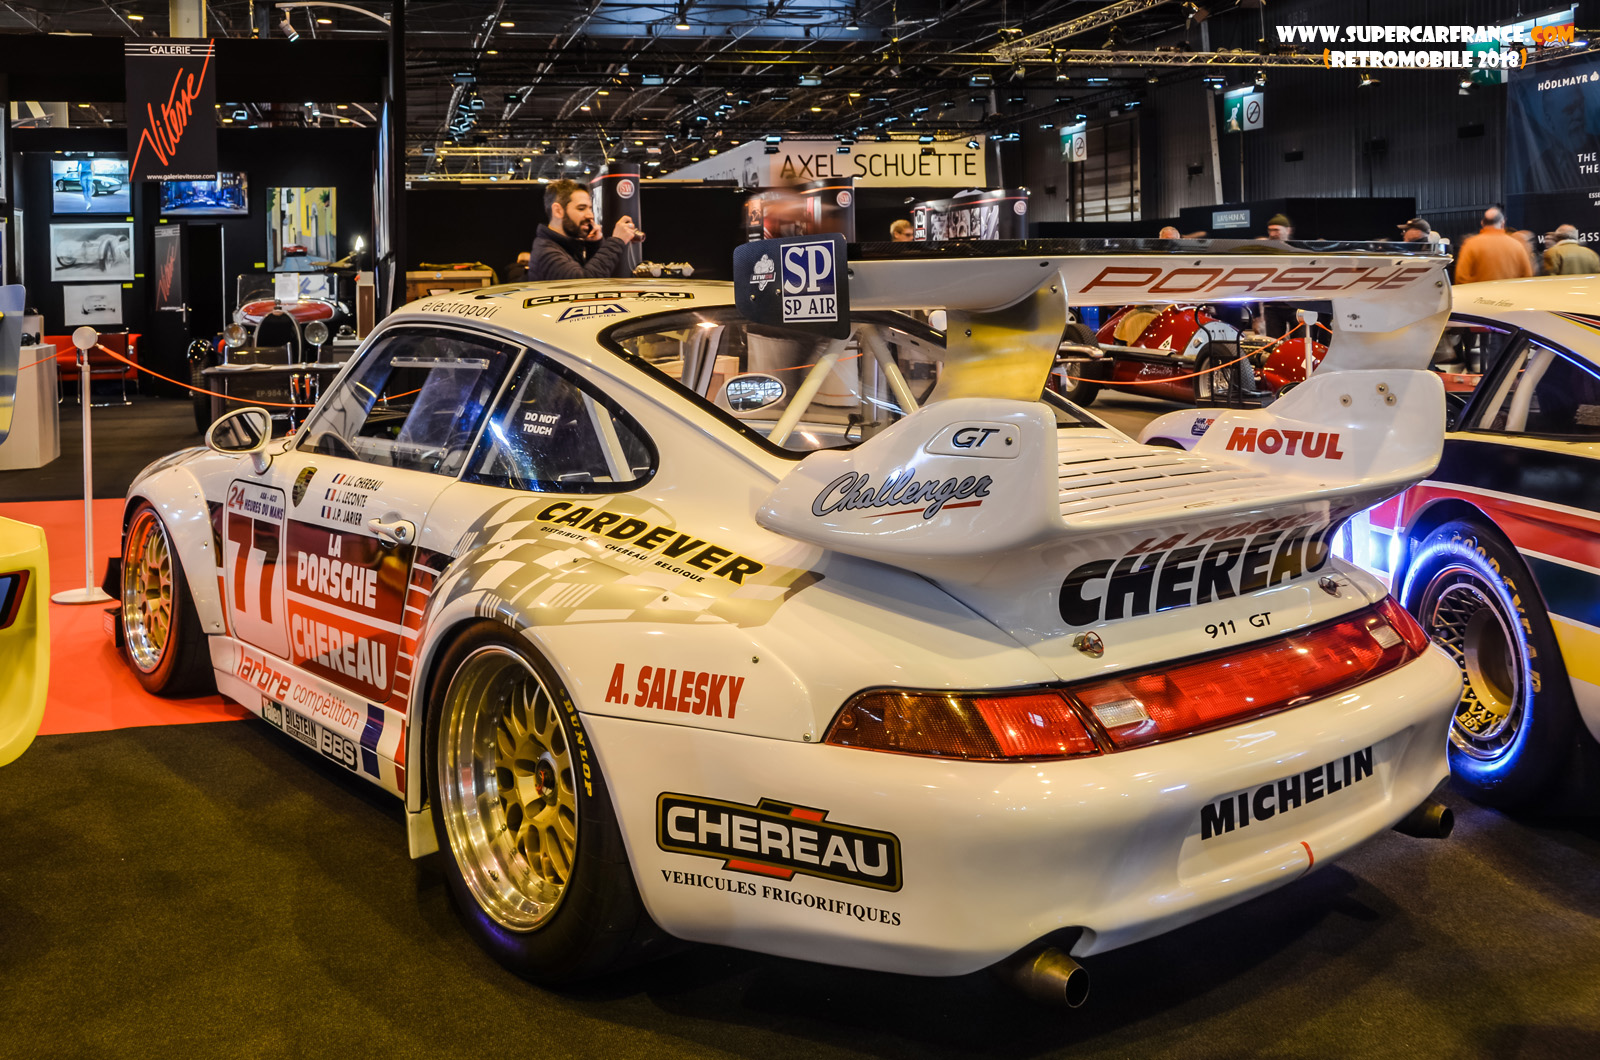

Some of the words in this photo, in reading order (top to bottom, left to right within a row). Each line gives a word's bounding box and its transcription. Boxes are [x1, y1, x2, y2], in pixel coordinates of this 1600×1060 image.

[149, 45, 191, 54] GALERIE
[1537, 73, 1588, 91] HÖDLMAYR
[129, 38, 215, 182] Vitesse
[779, 154, 843, 179] AXEL
[853, 153, 977, 178] SCHUETTE
[1577, 152, 1597, 163] THE
[146, 173, 216, 181] www.galerievitesse.com
[784, 244, 833, 295] SP
[1079, 266, 1433, 294] PORSCHE
[421, 300, 503, 319] electropoli
[530, 292, 686, 305] CHEREAU
[784, 299, 802, 316] SP
[808, 297, 836, 315] AIR
[522, 424, 553, 436] TOUCH
[524, 412, 538, 422] DO
[539, 414, 558, 425] NOT
[952, 427, 1000, 448] GT
[1225, 426, 1344, 460] MOTUL
[228, 485, 246, 510] 24
[354, 477, 384, 491] CHEREAU
[811, 467, 993, 519] Challenger
[244, 498, 262, 514] HEURES
[261, 503, 270, 516] DU
[269, 505, 284, 521] MANS
[342, 491, 368, 508] LECONTE
[343, 510, 363, 527] JARIER
[1123, 533, 1189, 556] LA
[1187, 504, 1354, 546] PORSCHE
[327, 533, 342, 558] LA
[535, 501, 766, 586] CARDEVER
[228, 511, 281, 624] 77
[604, 543, 650, 561] CHEREAU
[653, 560, 706, 584] BELGIQUE
[1059, 516, 1345, 627] CHEREAU
[296, 550, 378, 609] PORSCHE
[1204, 619, 1237, 639] 911
[1248, 611, 1271, 628] GT
[291, 613, 388, 690] CHEREAU
[604, 662, 630, 705] A.
[633, 665, 746, 720] SALESKY
[292, 682, 360, 730] compétition
[285, 707, 317, 740] BILSTEIN
[1458, 711, 1480, 731] BBS
[320, 726, 358, 770] BBS
[563, 699, 593, 797] DUNLOP
[1200, 745, 1374, 841] MICHELIN
[666, 806, 889, 877] CHEREAU
[660, 869, 757, 896] VEHICULES
[762, 885, 902, 926] FRIGORIFIQUES
